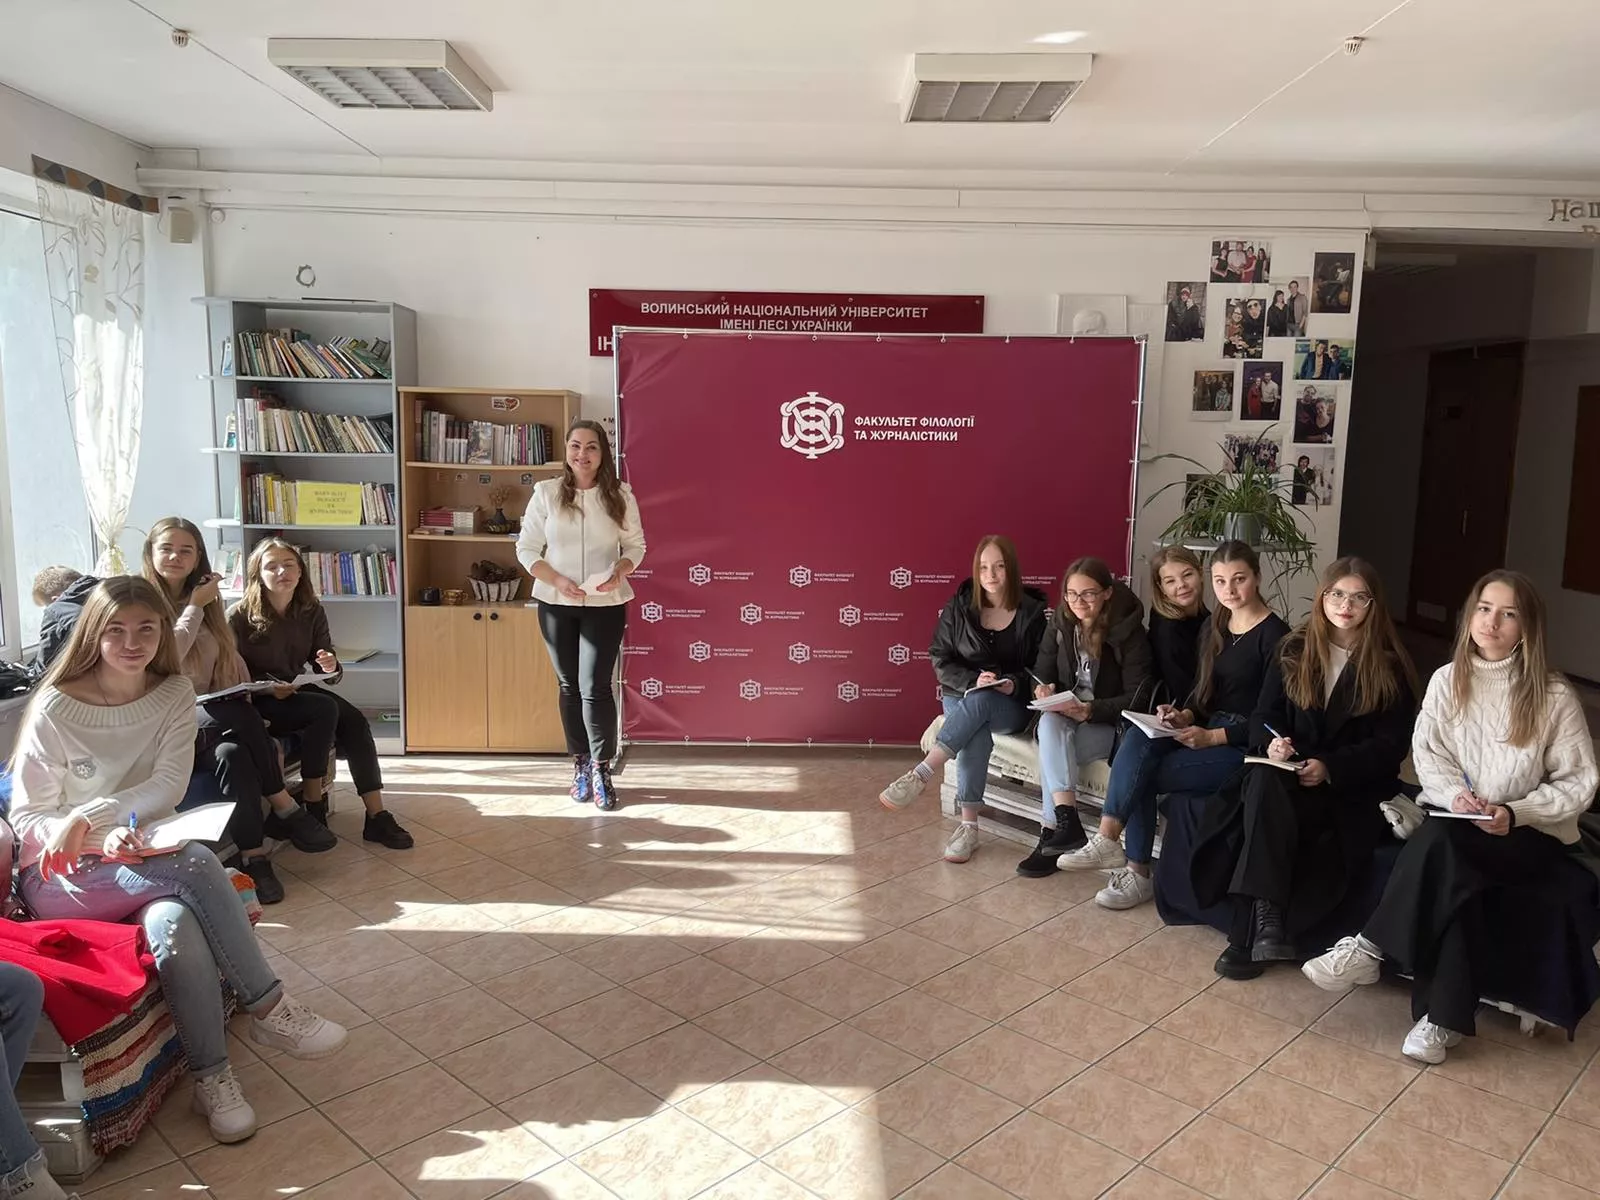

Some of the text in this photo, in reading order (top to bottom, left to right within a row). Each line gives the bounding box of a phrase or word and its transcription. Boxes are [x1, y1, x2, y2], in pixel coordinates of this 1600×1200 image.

[641, 301, 929, 318] ВОЛИНСЬКИЙ НАЦІОНАЛЬНИЙ УНІВЕРСИТЕТ
[720, 319, 853, 331] ІМЕНІ ЛЕСІ УКРАЇНКИ
[854, 415, 975, 427] ФАКУЛЬТЕТ ФІЛОЛОГІЇ
[854, 430, 958, 441] ТА ЖУРНАЛІСТИКИ
